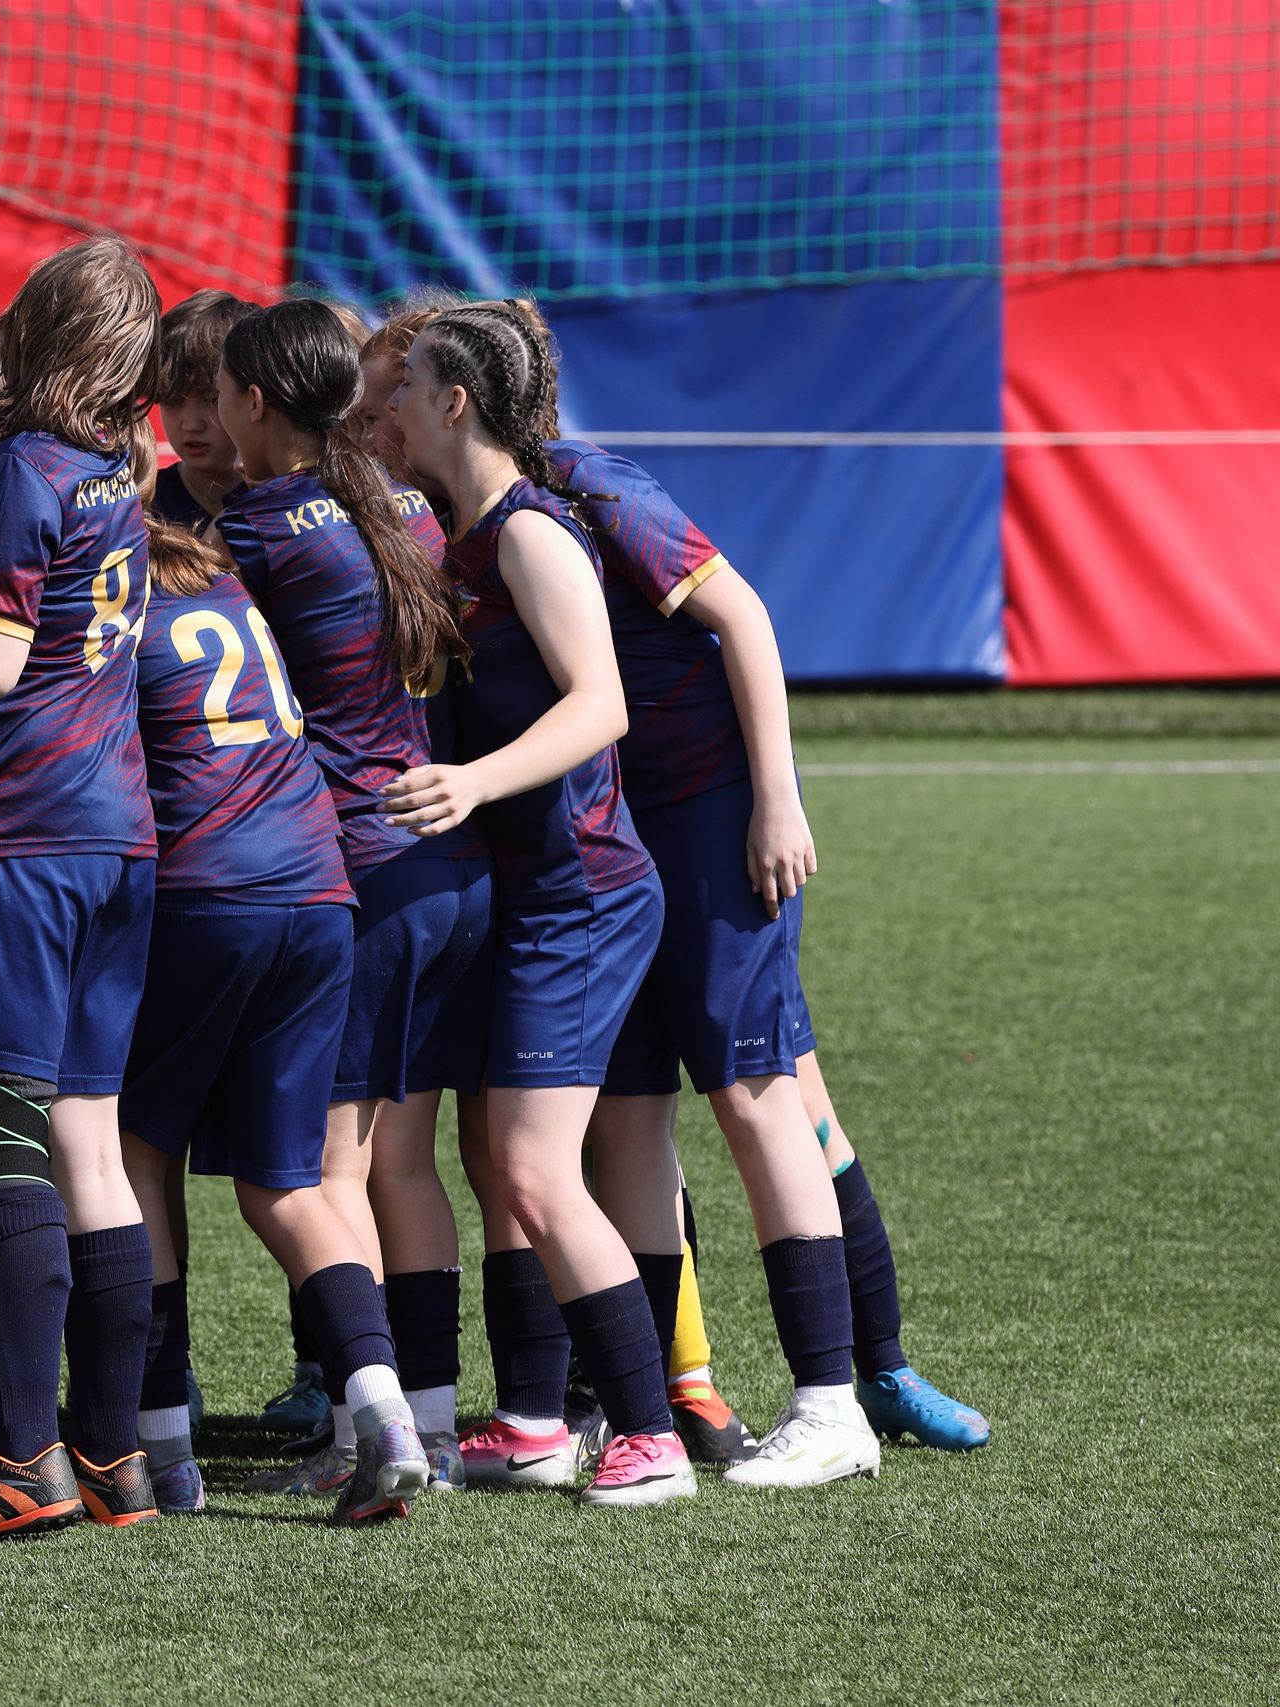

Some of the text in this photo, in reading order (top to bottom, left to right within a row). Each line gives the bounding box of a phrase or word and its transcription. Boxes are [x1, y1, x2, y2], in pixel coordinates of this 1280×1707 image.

[734, 1037, 766, 1048] surus
[517, 1051, 554, 1059] surus
[1, 1462, 41, 1481] Predator
